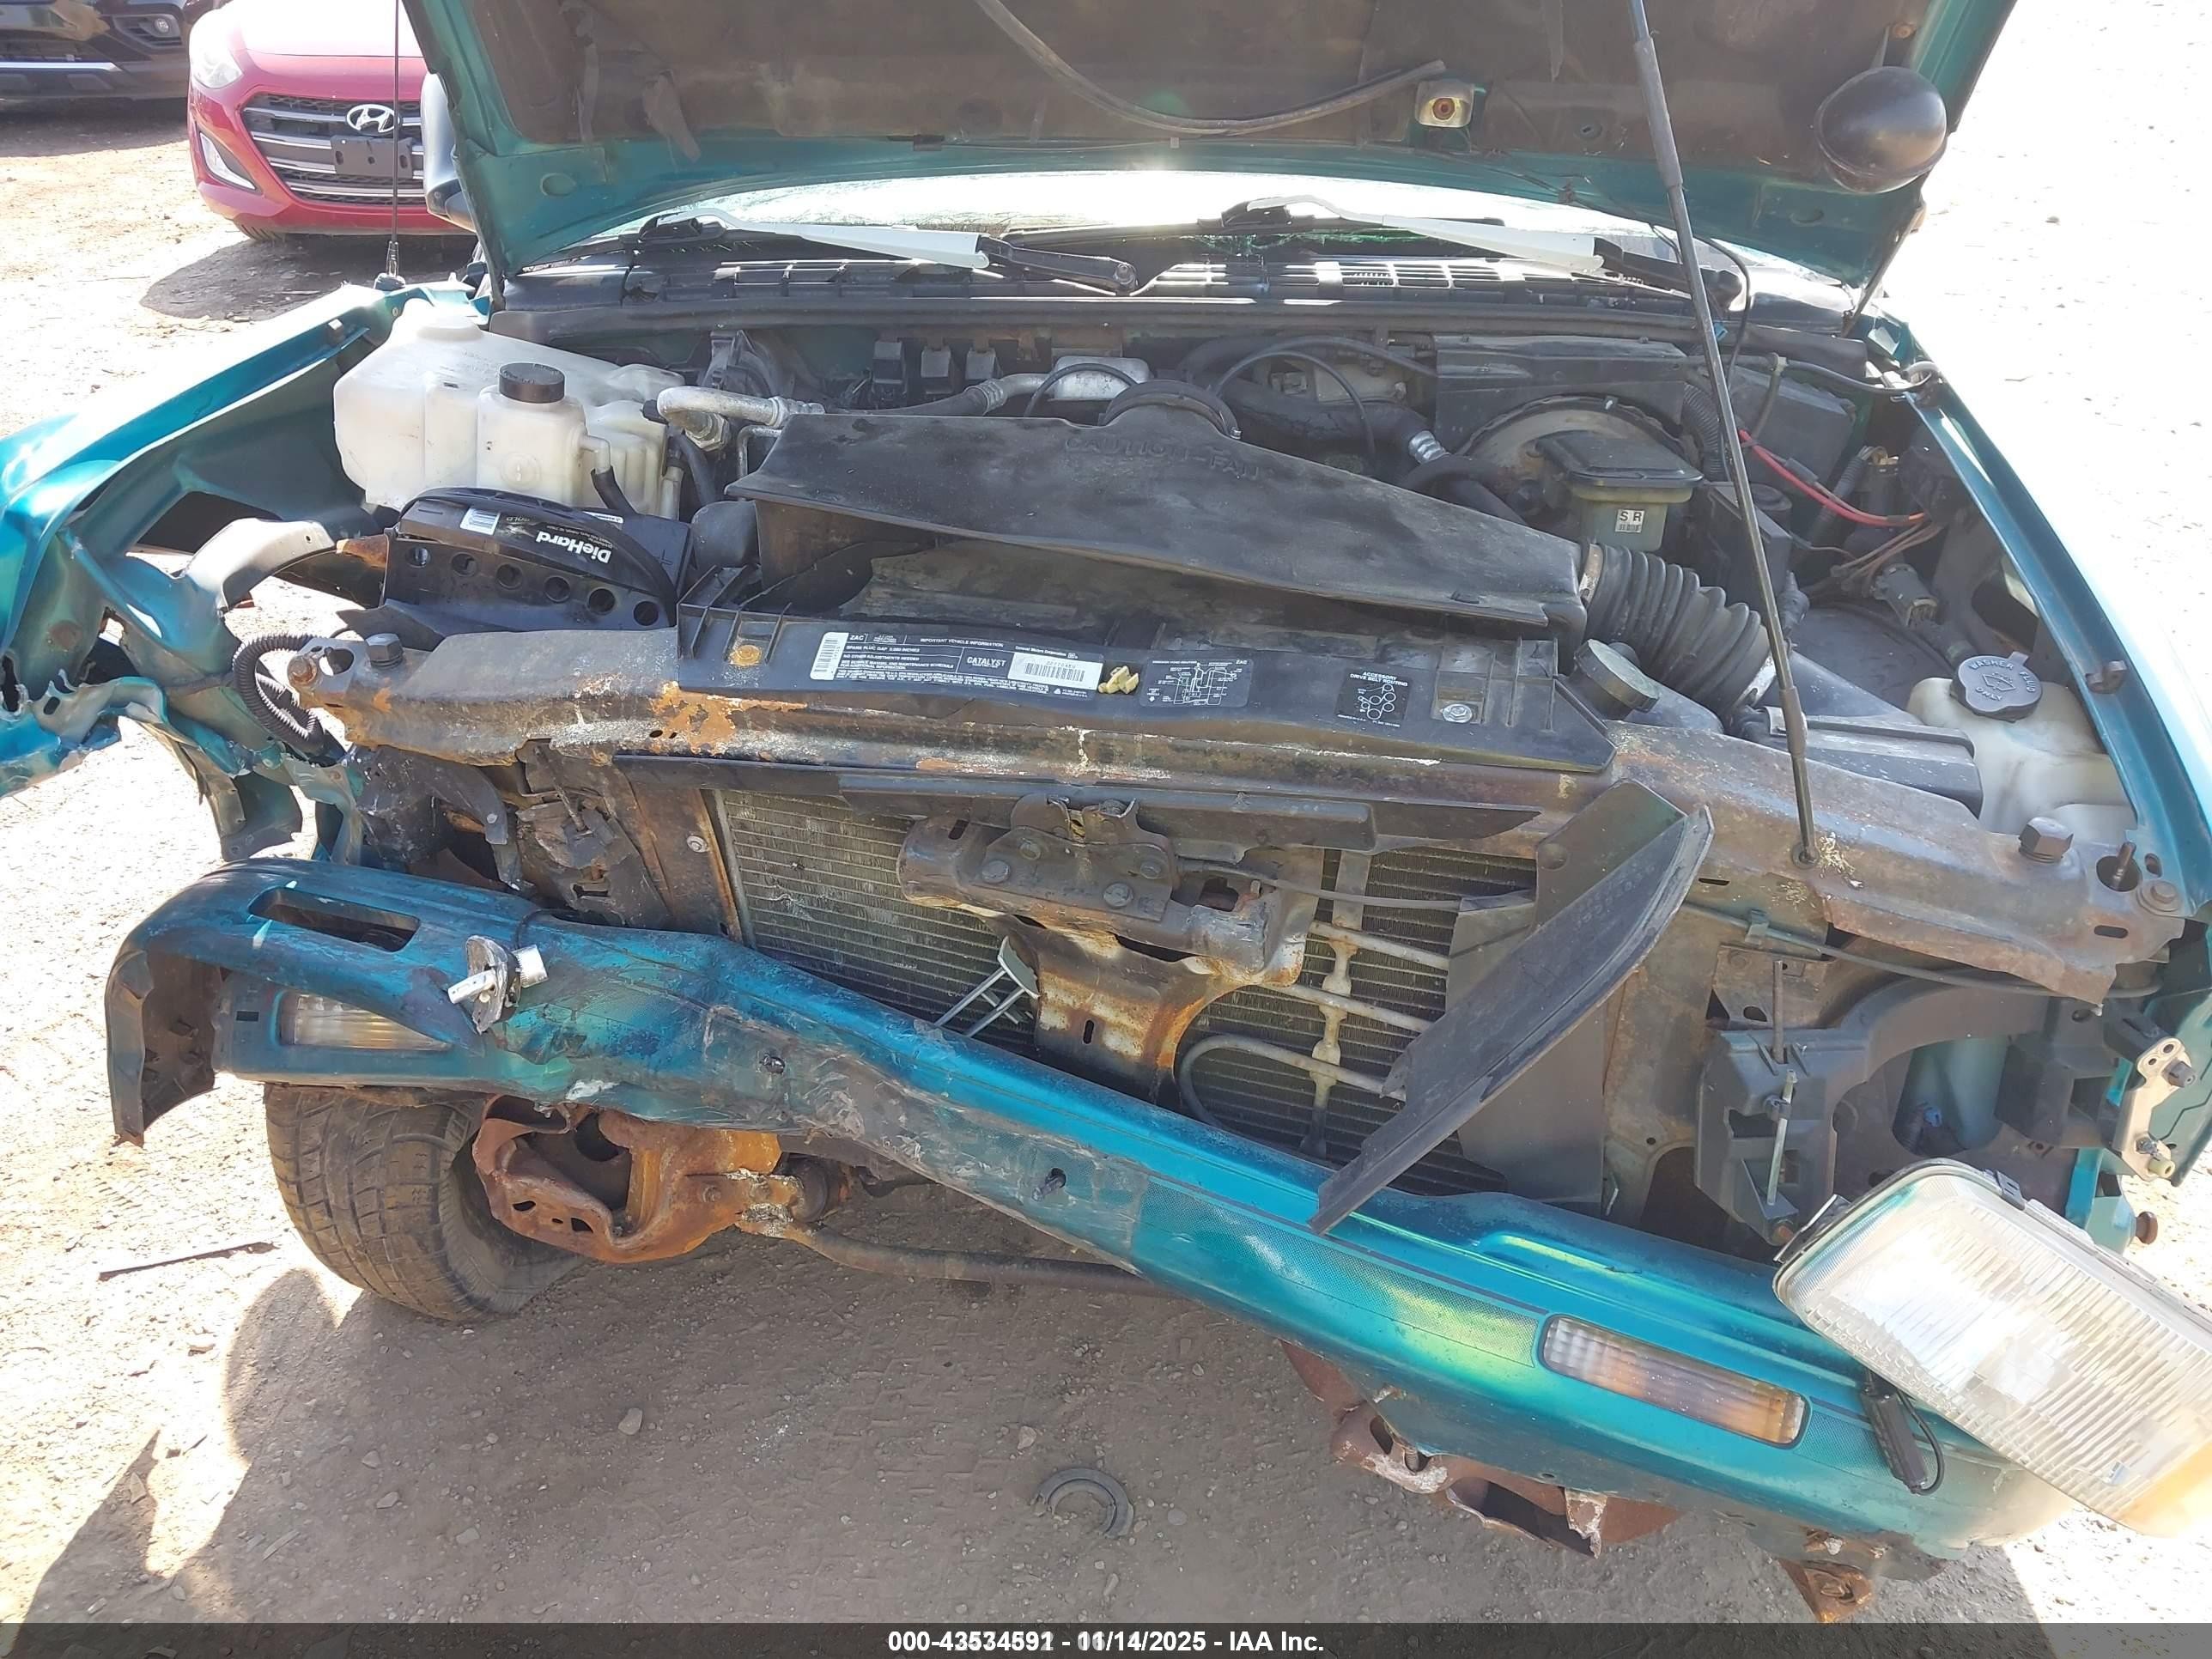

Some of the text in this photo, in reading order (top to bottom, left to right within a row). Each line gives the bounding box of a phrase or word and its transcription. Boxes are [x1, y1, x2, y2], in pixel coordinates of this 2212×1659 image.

[535, 531, 612, 563] DieHard
[967, 656, 1007, 667] CATALYST
[1362, 672, 1398, 681] ACCESSORY
[1382, 678, 1408, 687] ROUTING
[1968, 659, 2037, 693] WASHER FLUID
[1975, 686, 2003, 702] ONLY
